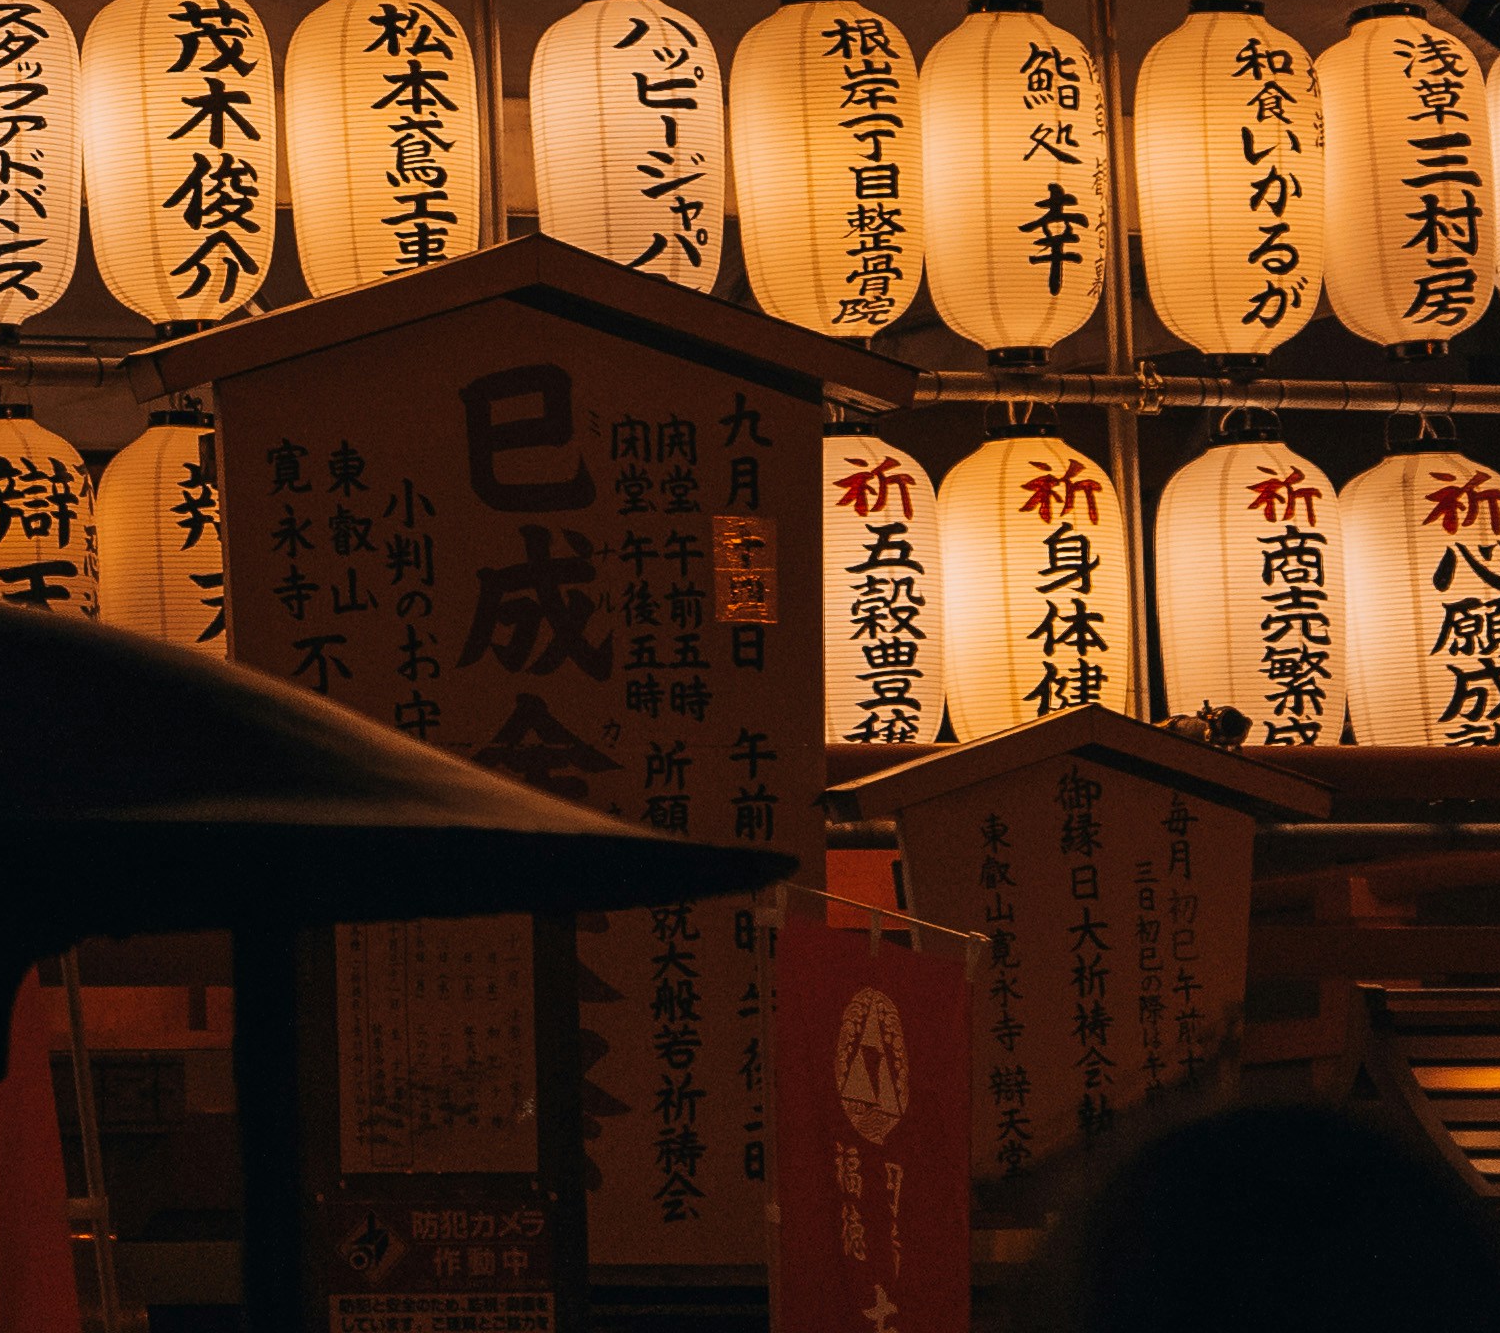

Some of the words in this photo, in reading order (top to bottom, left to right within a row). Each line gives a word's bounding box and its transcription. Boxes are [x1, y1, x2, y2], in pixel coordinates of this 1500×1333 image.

[613, 16, 707, 282] ハッピージャパ
[820, 18, 908, 326] 根岸一丁目整骨院
[1231, 37, 1309, 329] 和食いかるが
[1393, 33, 1484, 327] 浅草三村房
[266, 436, 321, 622] 寛永寺
[326, 439, 380, 616] 東叡山
[410, 1209, 546, 1240] 防犯カメラ
[432, 1246, 530, 1278] 作動中
